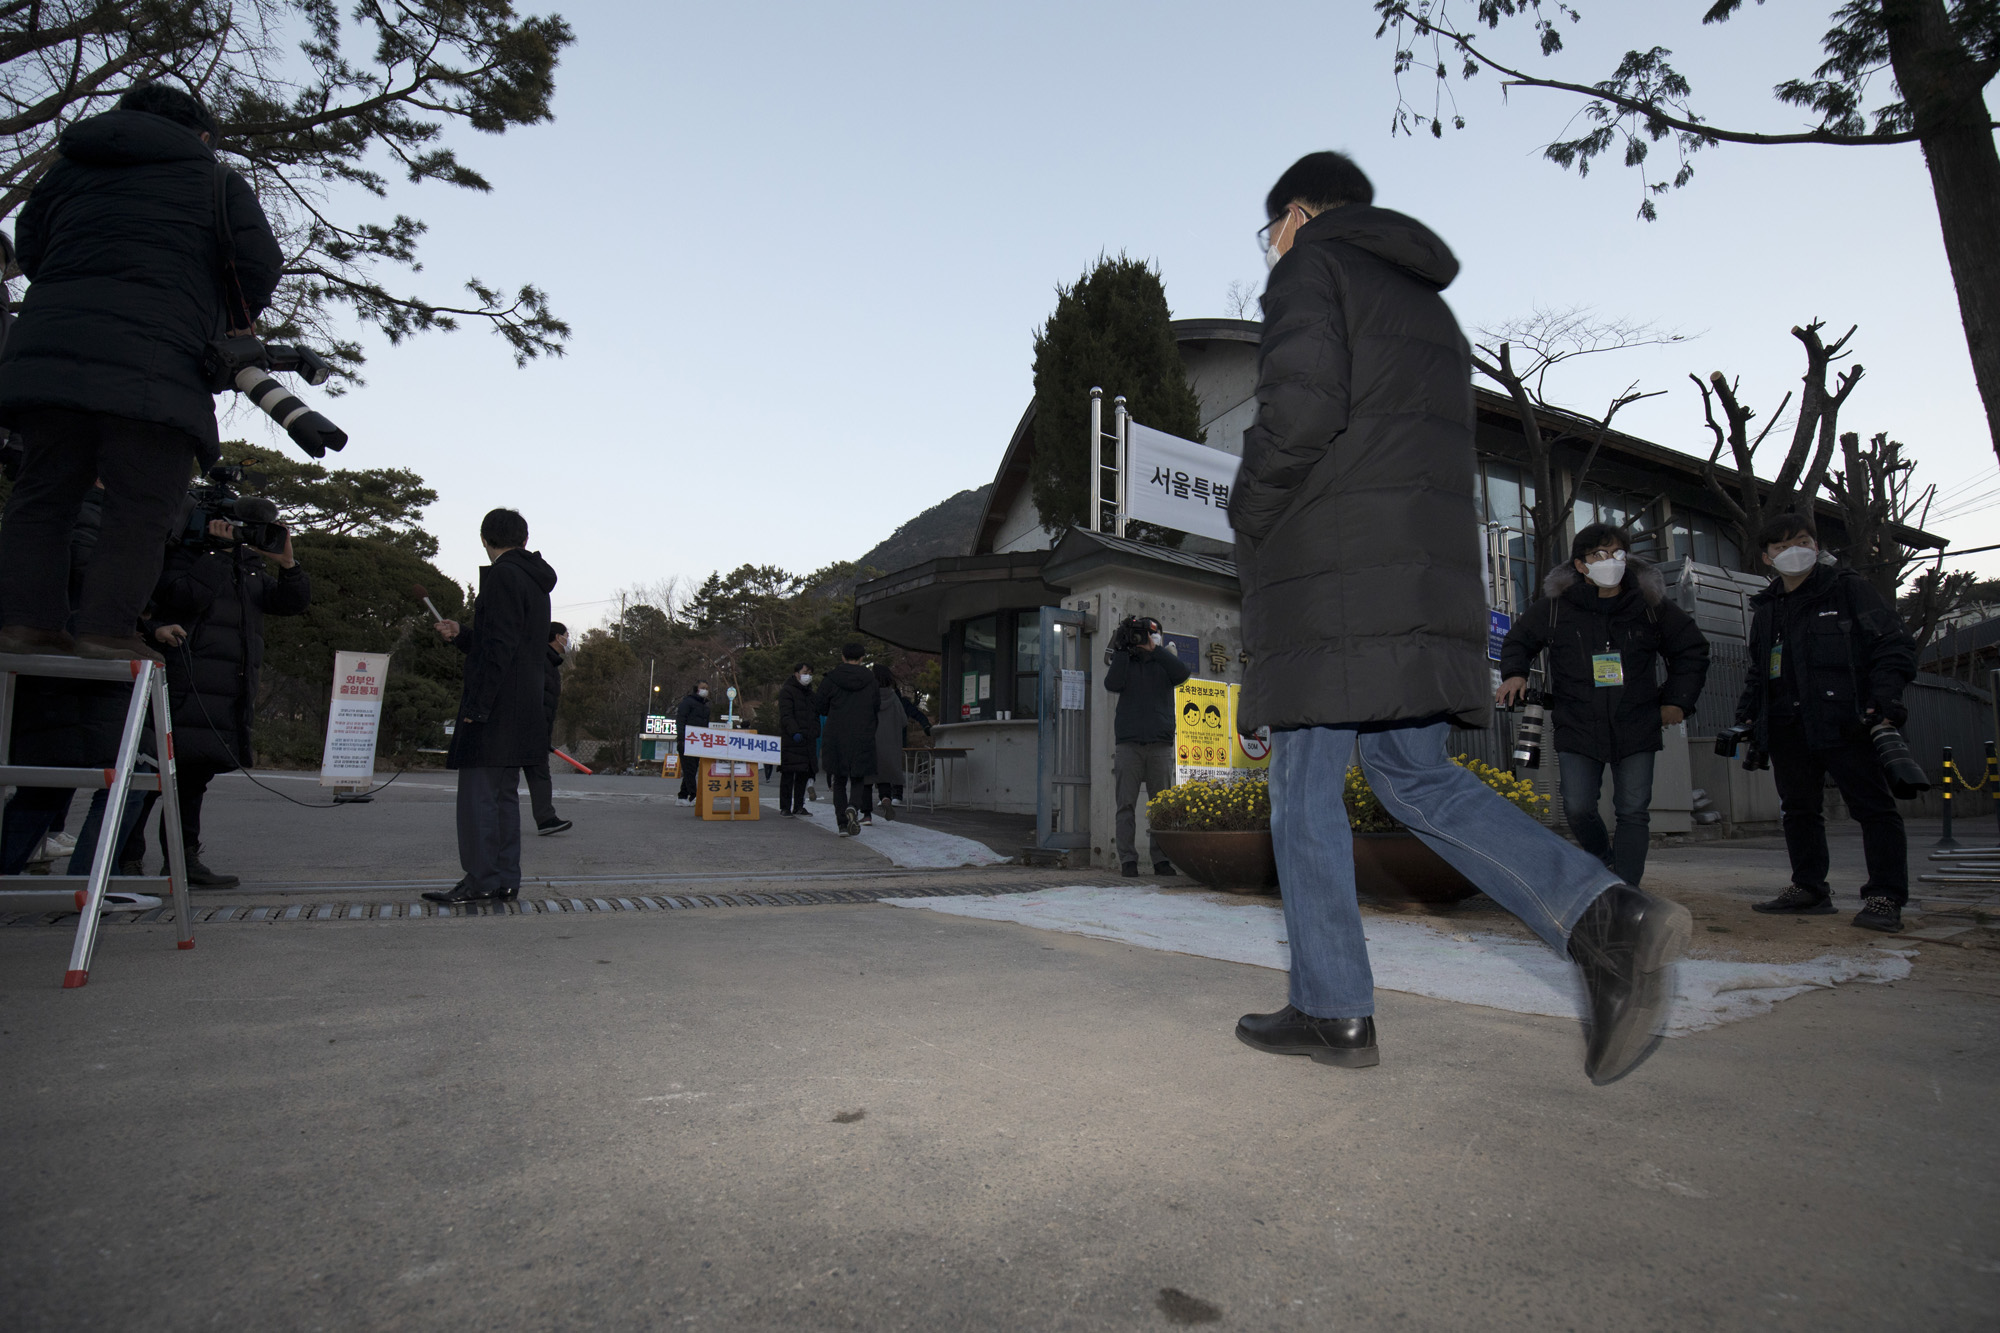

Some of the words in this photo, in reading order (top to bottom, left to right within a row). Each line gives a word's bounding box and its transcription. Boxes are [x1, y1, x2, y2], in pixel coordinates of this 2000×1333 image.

[1150, 466, 1229, 511] 서울특별
[346, 675, 375, 686] 외부인
[340, 685, 379, 696] 출입통제
[1178, 684, 1226, 699] 교육환경보호구역
[685, 731, 728, 748] 수험표
[729, 735, 781, 753] 꺼내세요
